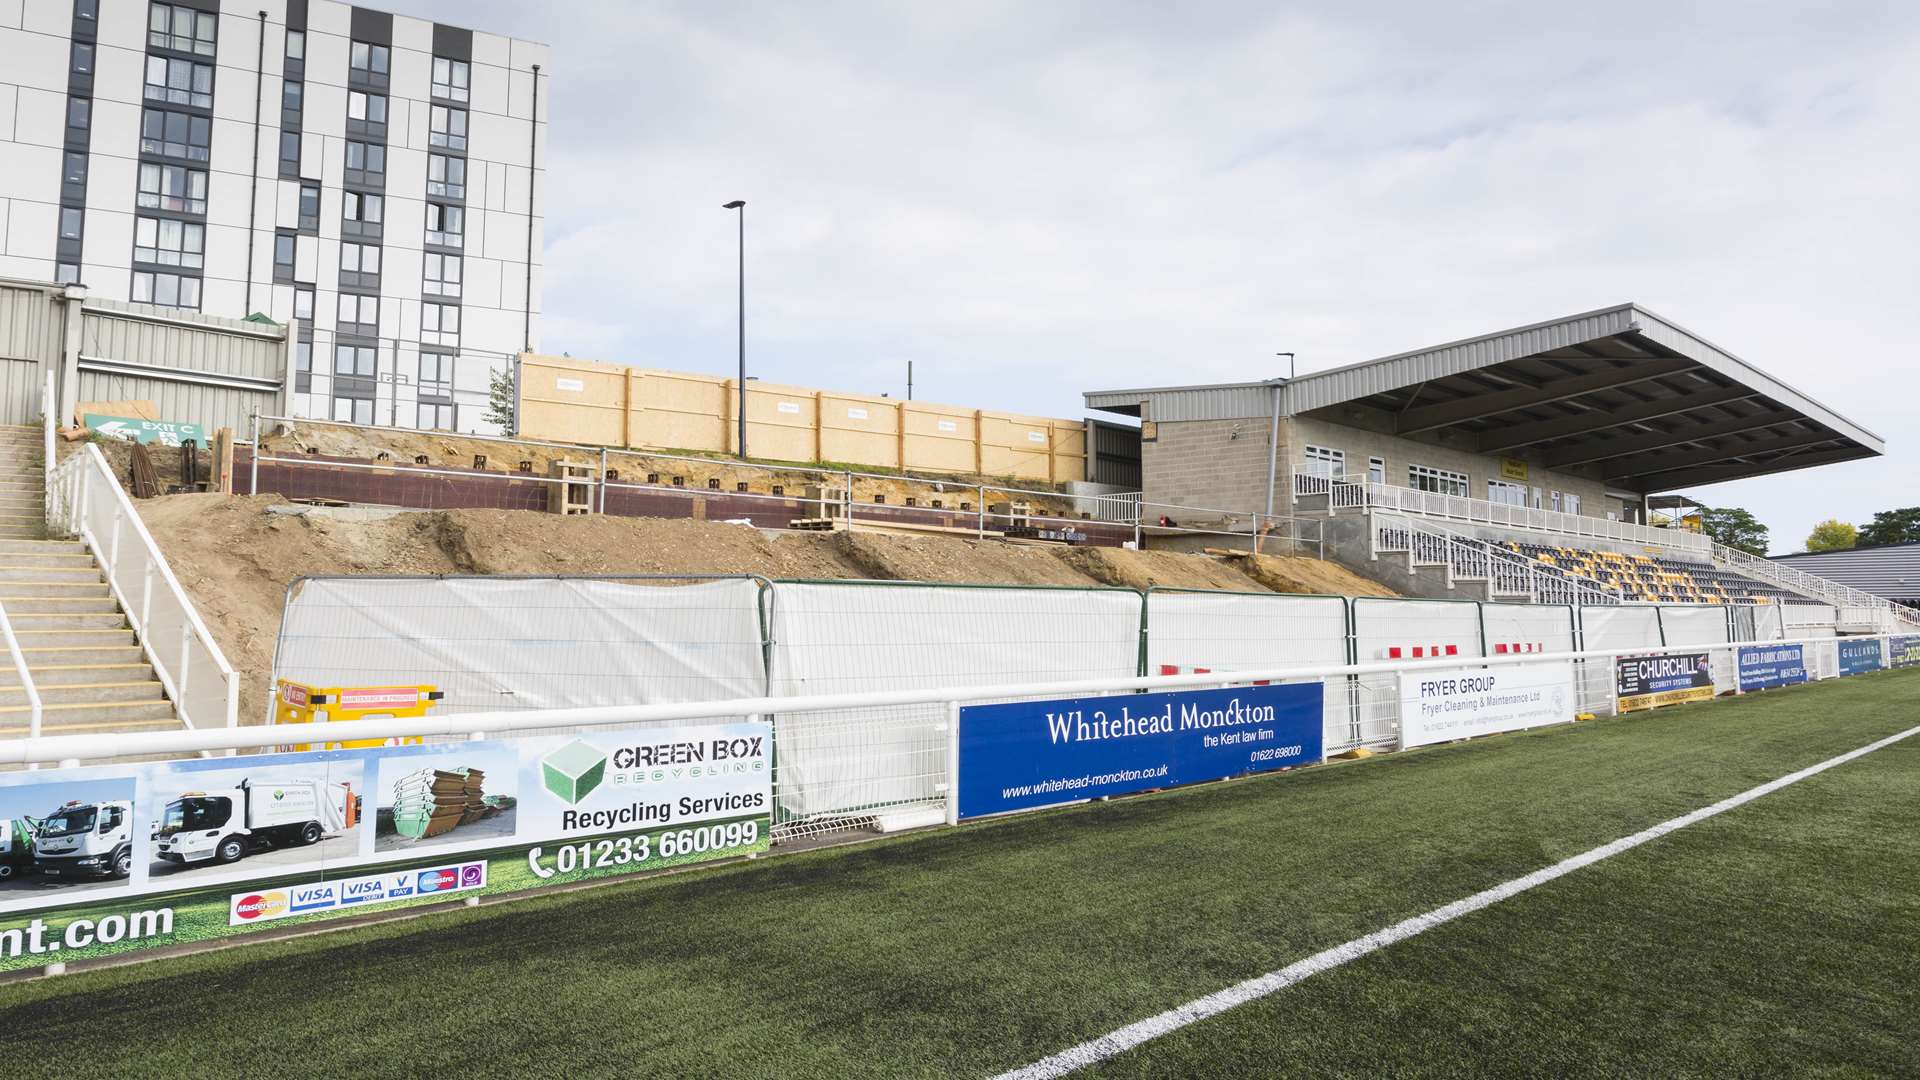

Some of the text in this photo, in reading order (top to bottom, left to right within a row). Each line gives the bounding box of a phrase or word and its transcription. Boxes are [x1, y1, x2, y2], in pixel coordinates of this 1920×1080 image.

[142, 421, 195, 434] EXIT C
[1639, 657, 1697, 679] CHURCHILL
[1741, 652, 1760, 665] ALLIED
[1421, 676, 1495, 698] FRYER GROUP
[1649, 677, 1692, 689] SECURITY SYSTEMS
[1421, 691, 1541, 717] Fryer Cleaning & Maintenance Ltd
[1047, 698, 1275, 744] Whitehead Monckton
[1204, 728, 1274, 748] the Kent law firm
[613, 736, 763, 769] GREEN BOX
[1251, 745, 1301, 762] 01622 698000
[614, 760, 764, 784] RECYCLING
[1002, 764, 1168, 799] www.whitehead-monckton.co.uk
[562, 791, 764, 831] Recycling Services
[557, 820, 758, 873] 01233 660099
[348, 881, 383, 895] VISA
[396, 875, 408, 887] V
[423, 875, 454, 886] Maestro
[297, 887, 333, 903] VISA
[363, 893, 383, 901] DEBIT
[394, 887, 408, 896] PAY
[0, 908, 174, 957] nt.com
